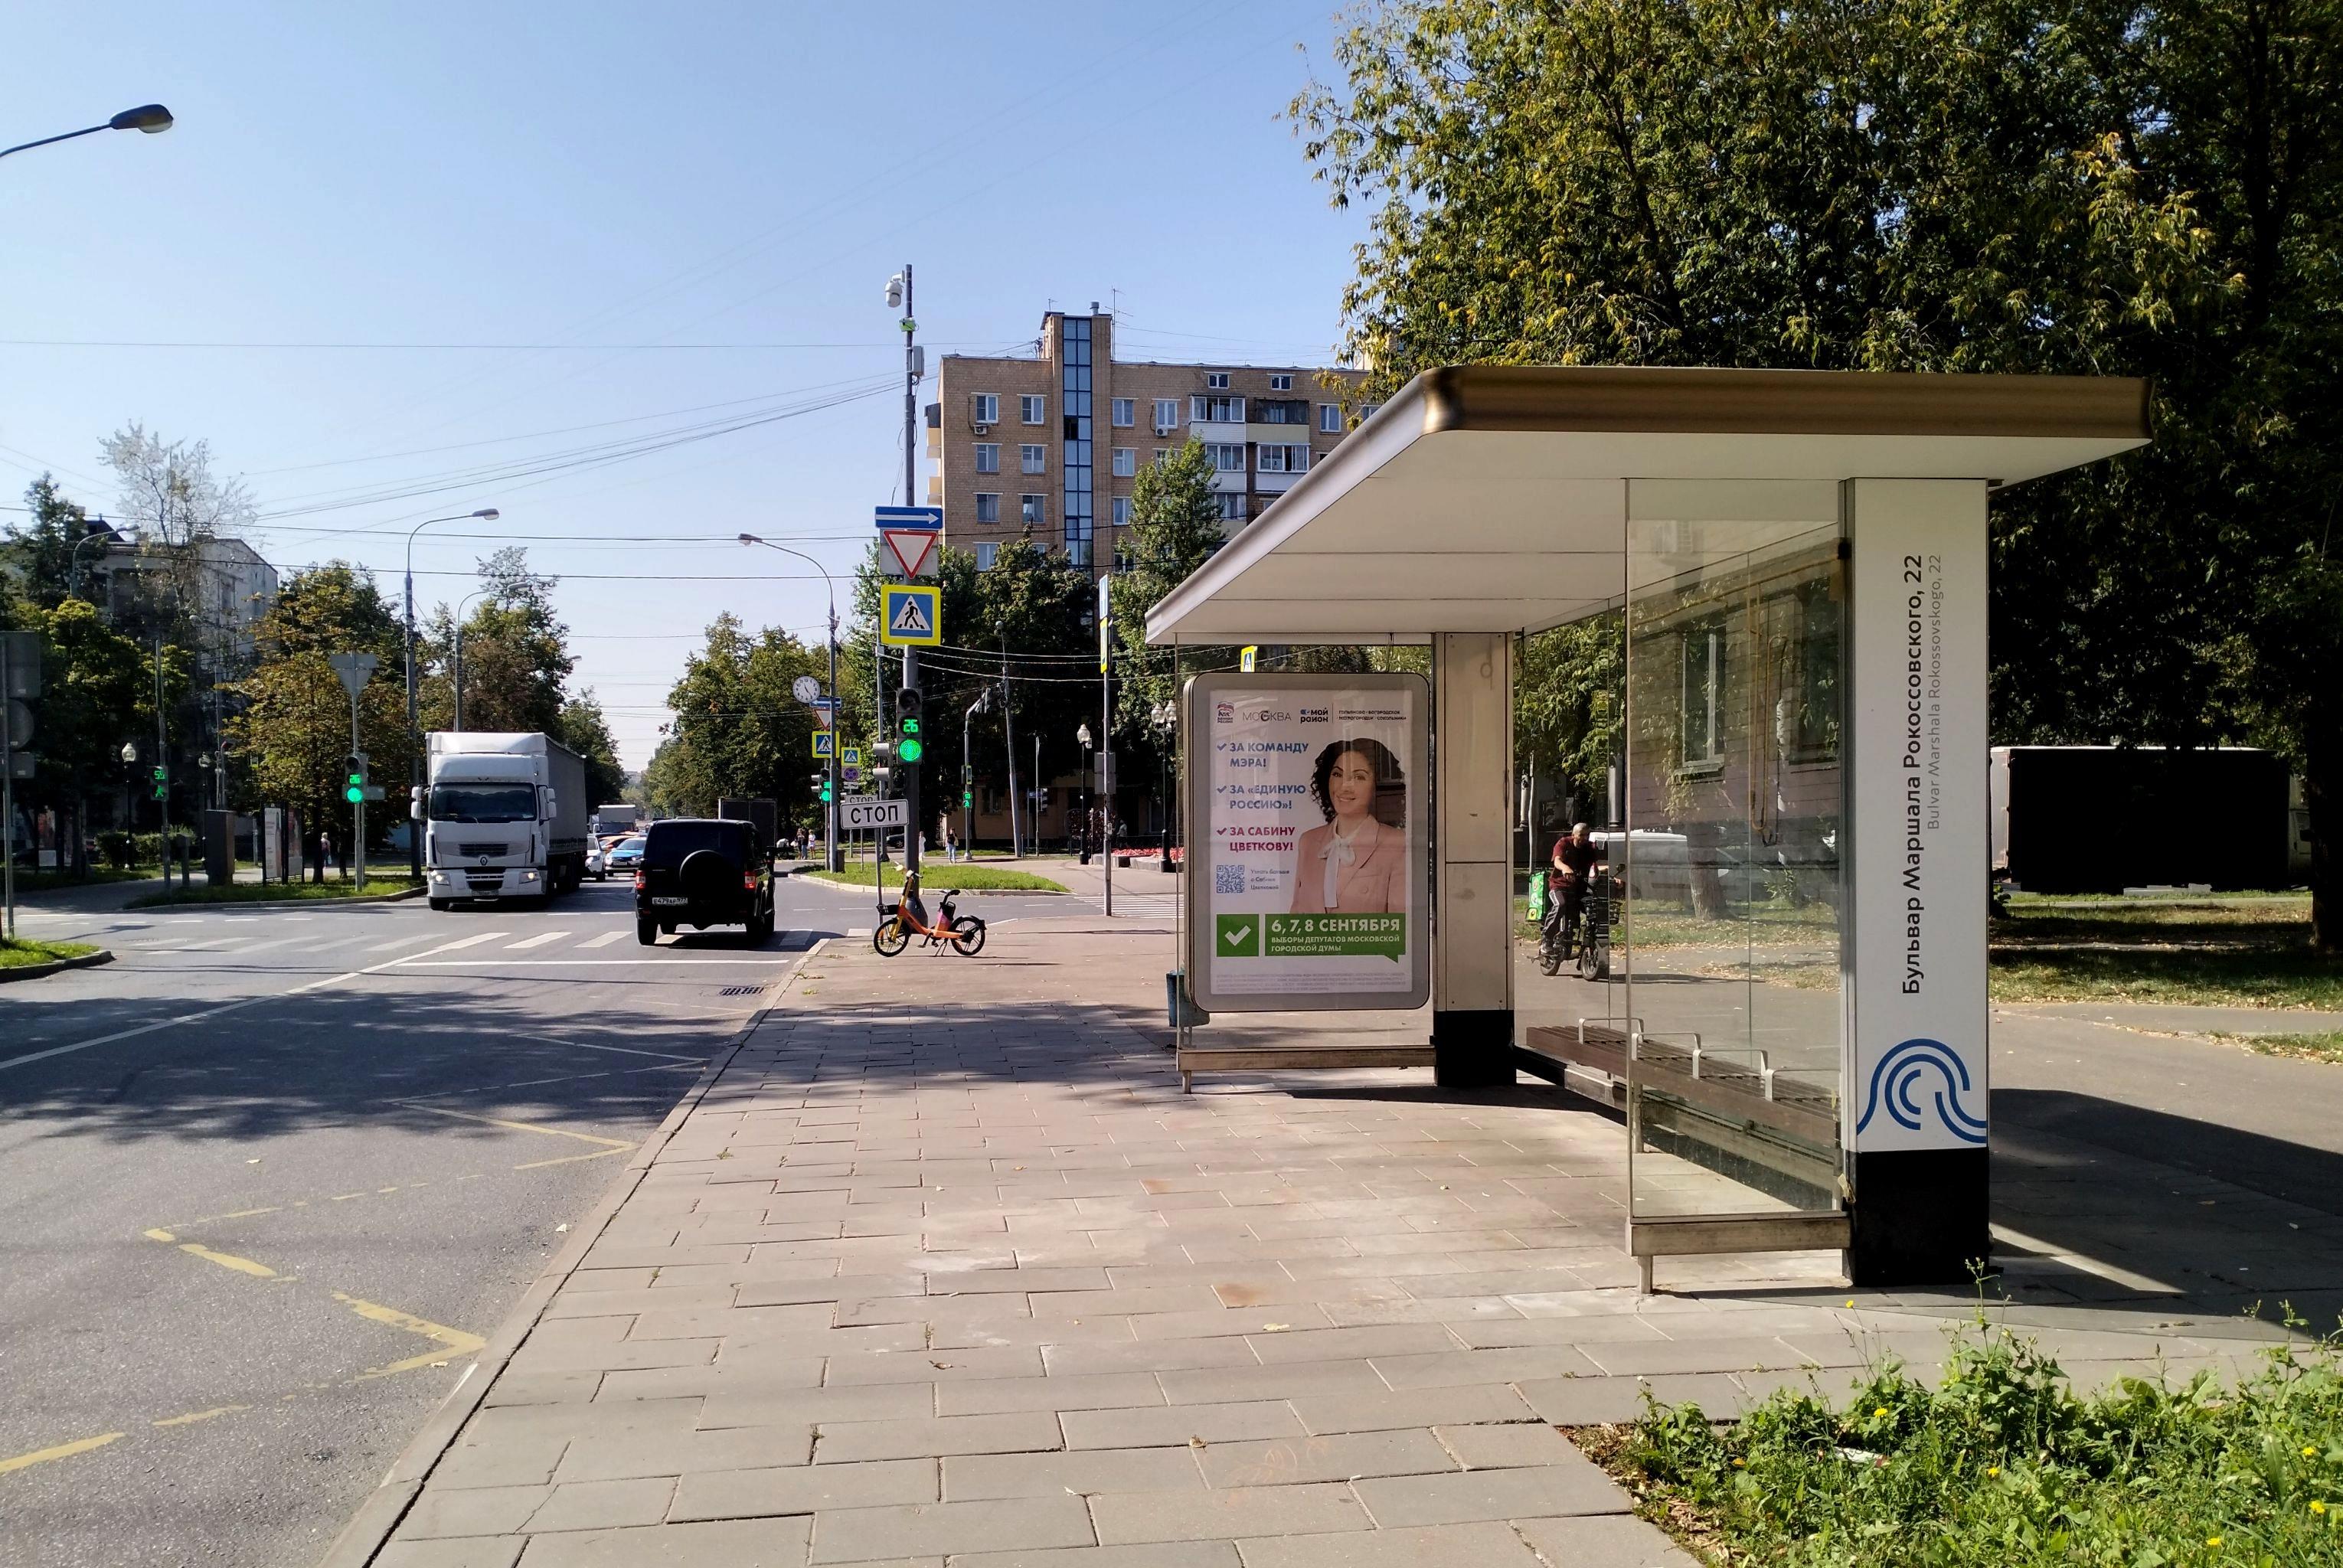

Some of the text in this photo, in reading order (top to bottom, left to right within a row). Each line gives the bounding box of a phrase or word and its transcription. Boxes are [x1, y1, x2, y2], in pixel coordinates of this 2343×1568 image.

[1927, 554, 1943, 829] Bulvar Marshala Rokossovskogo, 22
[1243, 710, 1292, 721] МОСКВА
[903, 719, 919, 733] 26
[1230, 743, 1309, 753] ЗА КОМАНДУ
[1230, 758, 1266, 767] МЭРА!
[1903, 555, 1925, 994] Бульвар Маршала Рокоссовского, 22
[1230, 785, 1306, 795] ЗА «ЕДИНУЮ
[1230, 800, 1292, 809] РОССИЮ»!
[850, 805, 898, 825] СТОП
[1230, 827, 1296, 836] ЗА САБИНУ
[1230, 842, 1293, 852] ЦВЕТКОВУ!
[1319, 920, 1400, 932] СЕНТЯБРЯ
[1305, 936, 1346, 944] ДЕПУТАТОВ
[1347, 934, 1400, 942] МОСКОВСКОЙ
